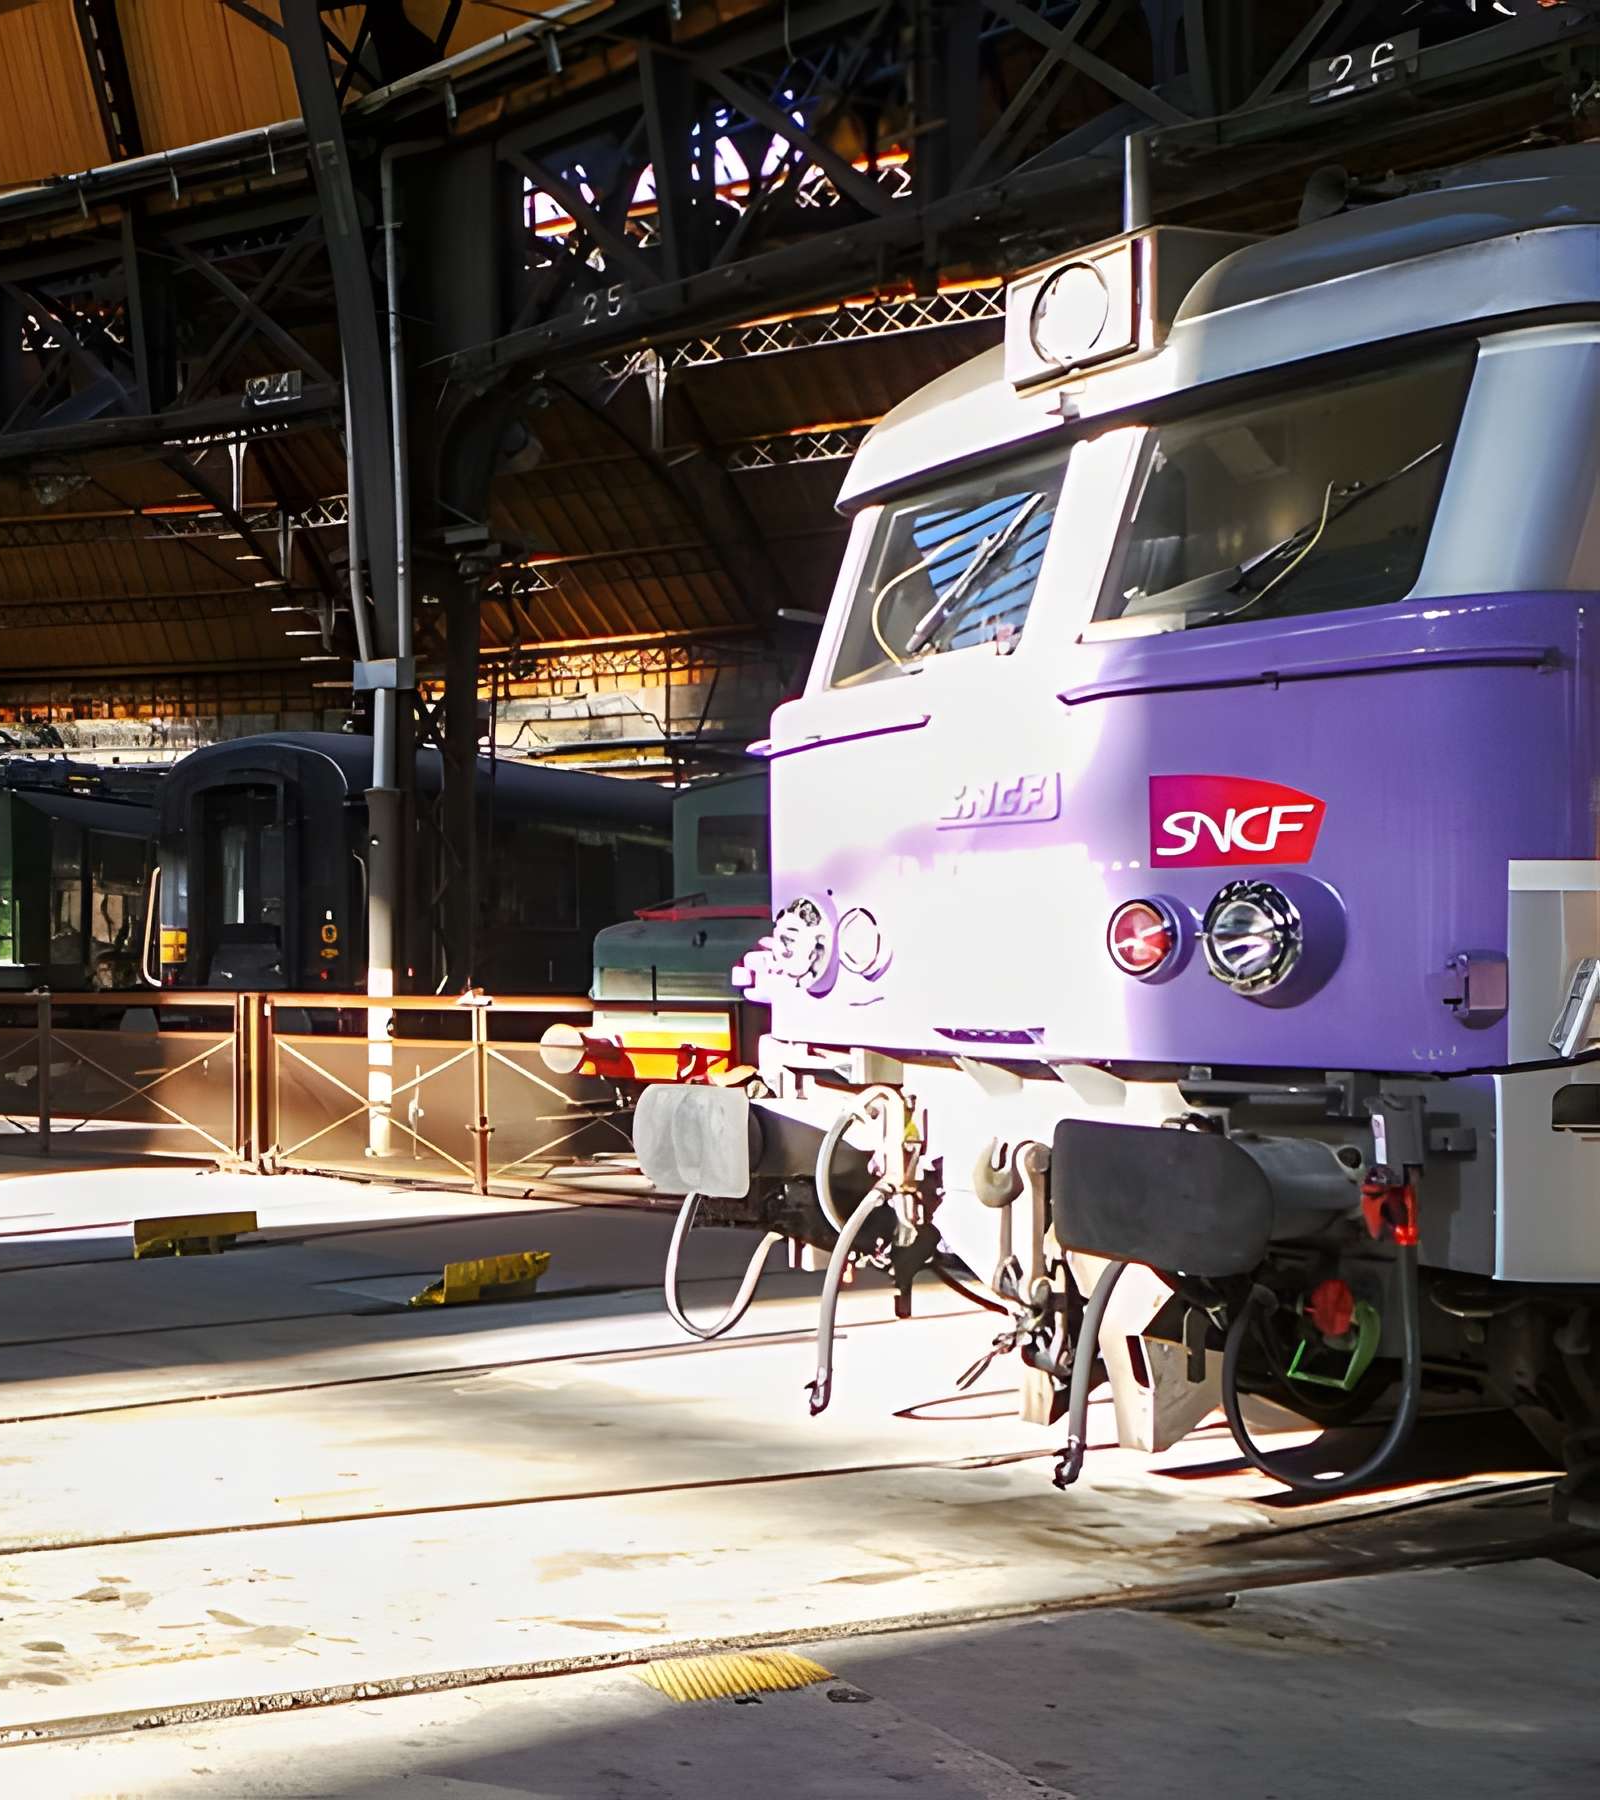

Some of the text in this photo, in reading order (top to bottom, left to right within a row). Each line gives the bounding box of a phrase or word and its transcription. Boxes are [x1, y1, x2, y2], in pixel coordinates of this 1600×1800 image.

[1328, 42, 1397, 98] 26
[582, 283, 624, 325] 25
[1156, 804, 1314, 856] SNCF
